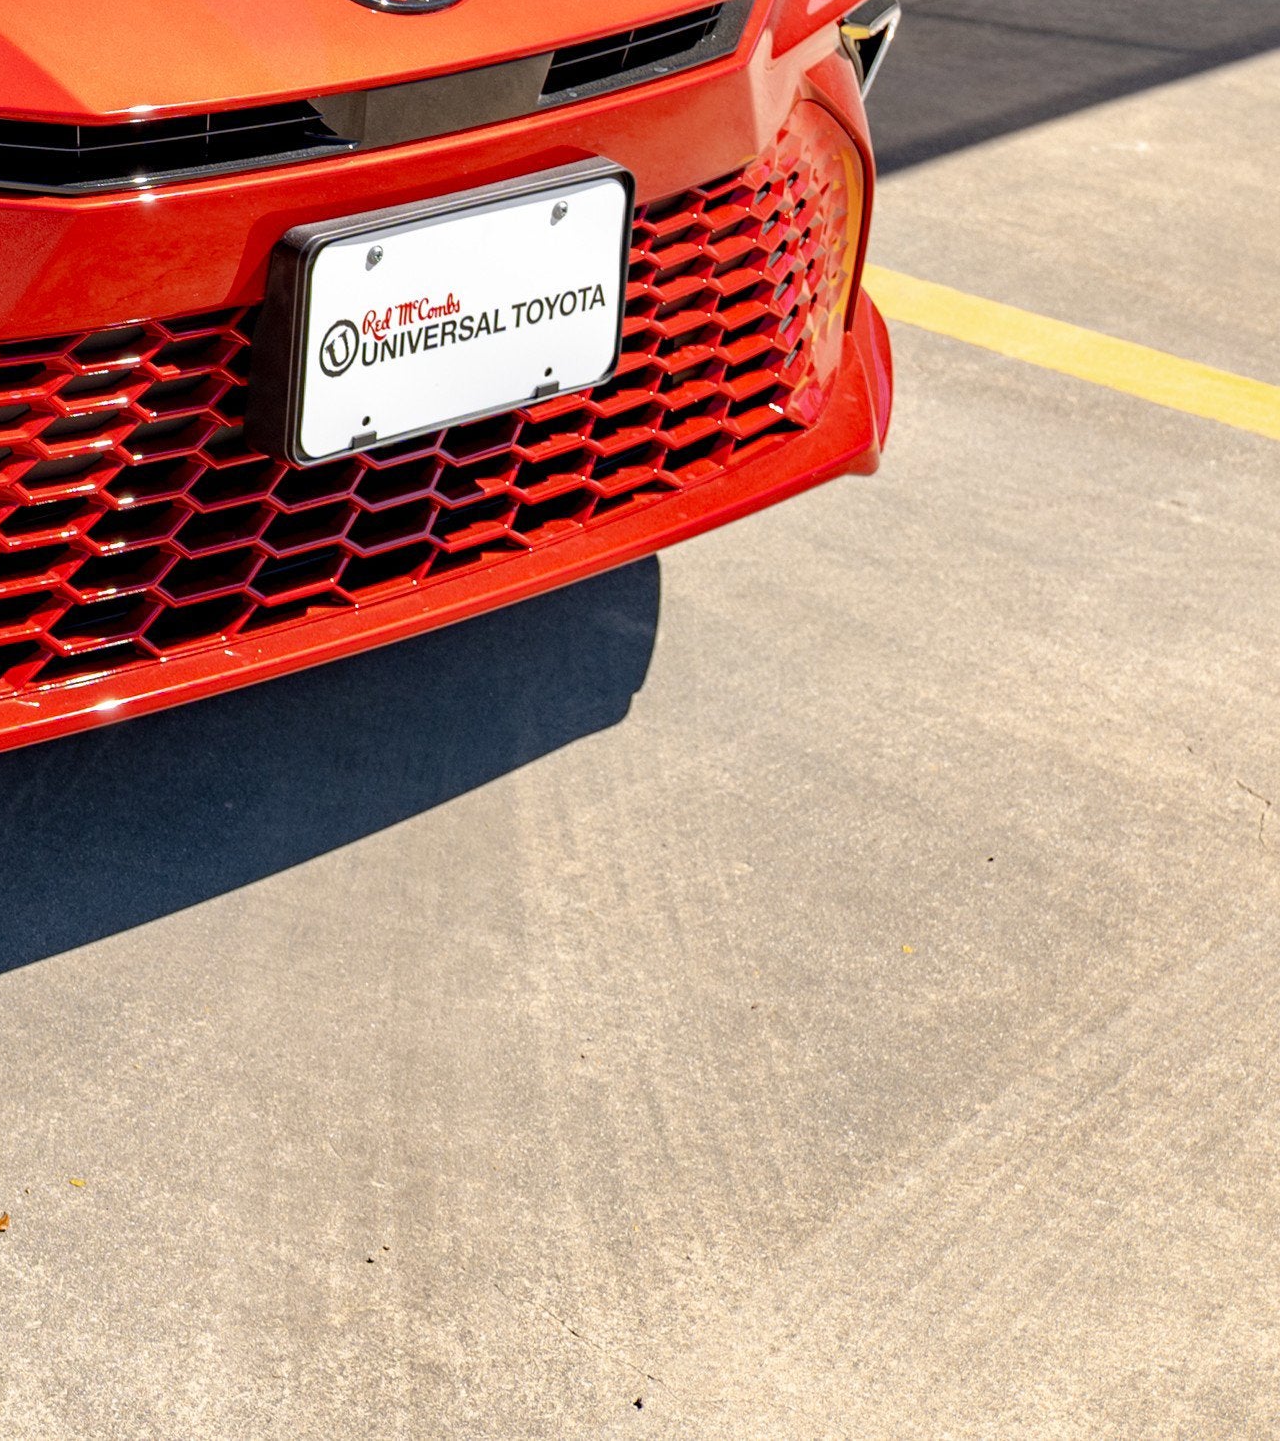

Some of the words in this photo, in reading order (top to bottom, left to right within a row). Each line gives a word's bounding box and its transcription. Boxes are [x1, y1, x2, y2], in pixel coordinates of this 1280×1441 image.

[361, 307, 507, 366] UNIVERSAL
[511, 284, 606, 329] TOYOTA
[362, 305, 392, 341] Red
[395, 292, 461, 328] McCombs
